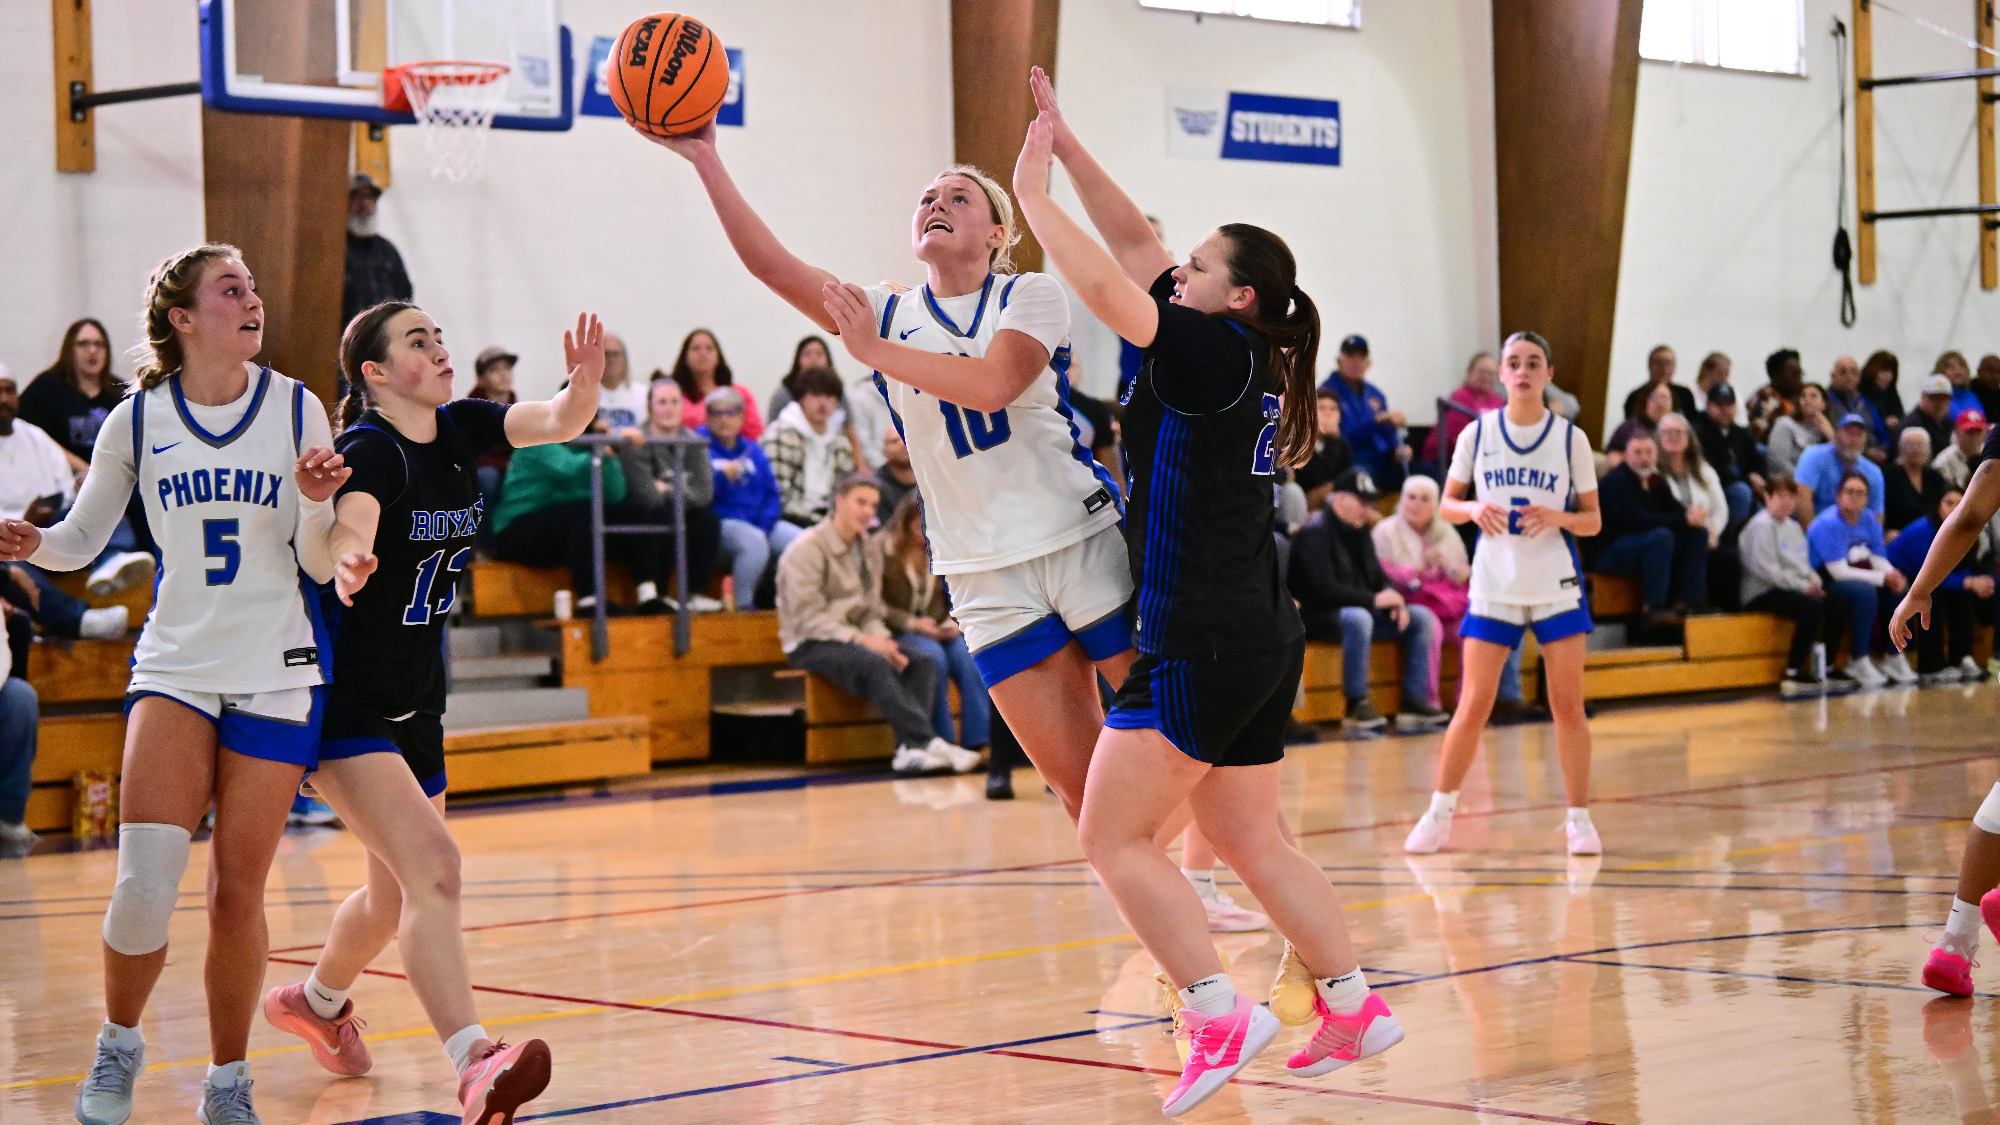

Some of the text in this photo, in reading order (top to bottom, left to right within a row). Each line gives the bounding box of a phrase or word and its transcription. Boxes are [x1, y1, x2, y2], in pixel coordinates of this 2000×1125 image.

[630, 18, 661, 68] NCAA
[658, 20, 703, 86] Wilson
[1231, 110, 1338, 149] STUDENTS
[1251, 420, 1277, 475] 2
[158, 468, 283, 512] PHOENIX
[1484, 467, 1559, 493] PHOENIX
[409, 493, 484, 540] ROYA
[202, 518, 242, 587] 5
